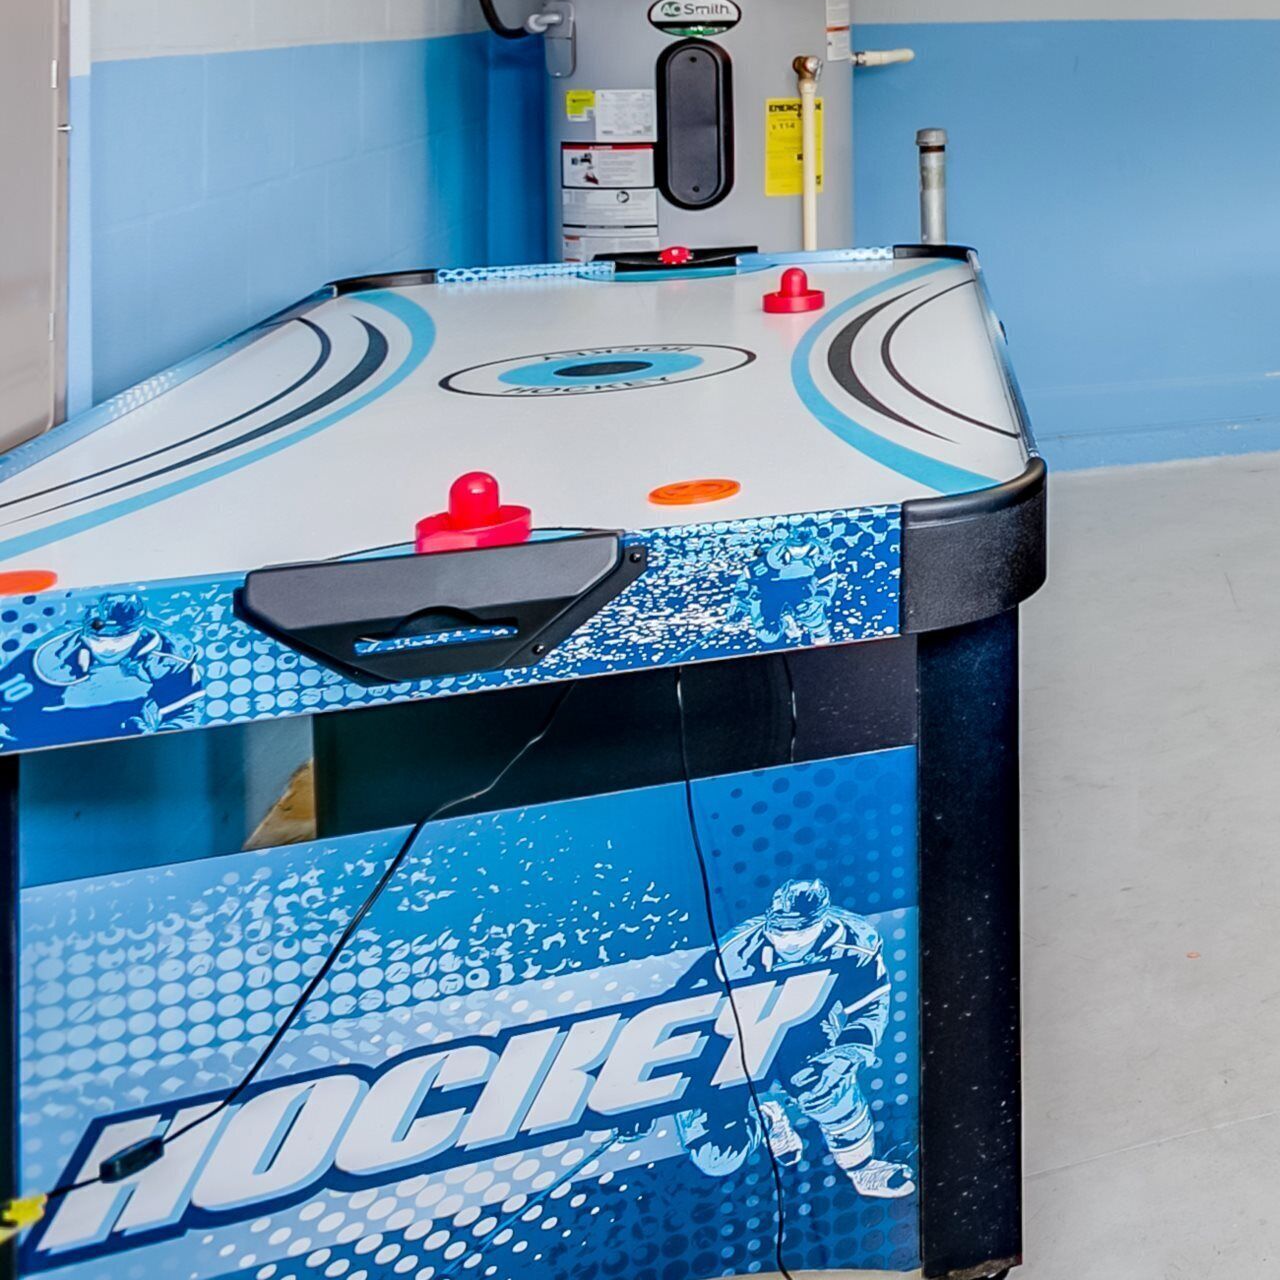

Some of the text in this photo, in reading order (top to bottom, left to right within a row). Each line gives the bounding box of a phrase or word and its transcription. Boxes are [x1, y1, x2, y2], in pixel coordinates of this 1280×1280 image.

[684, 3, 730, 15] Smith
[545, 346, 694, 362] HOCKEY
[502, 376, 669, 394] HOCKEY
[36, 969, 837, 1253] HOCKEY
